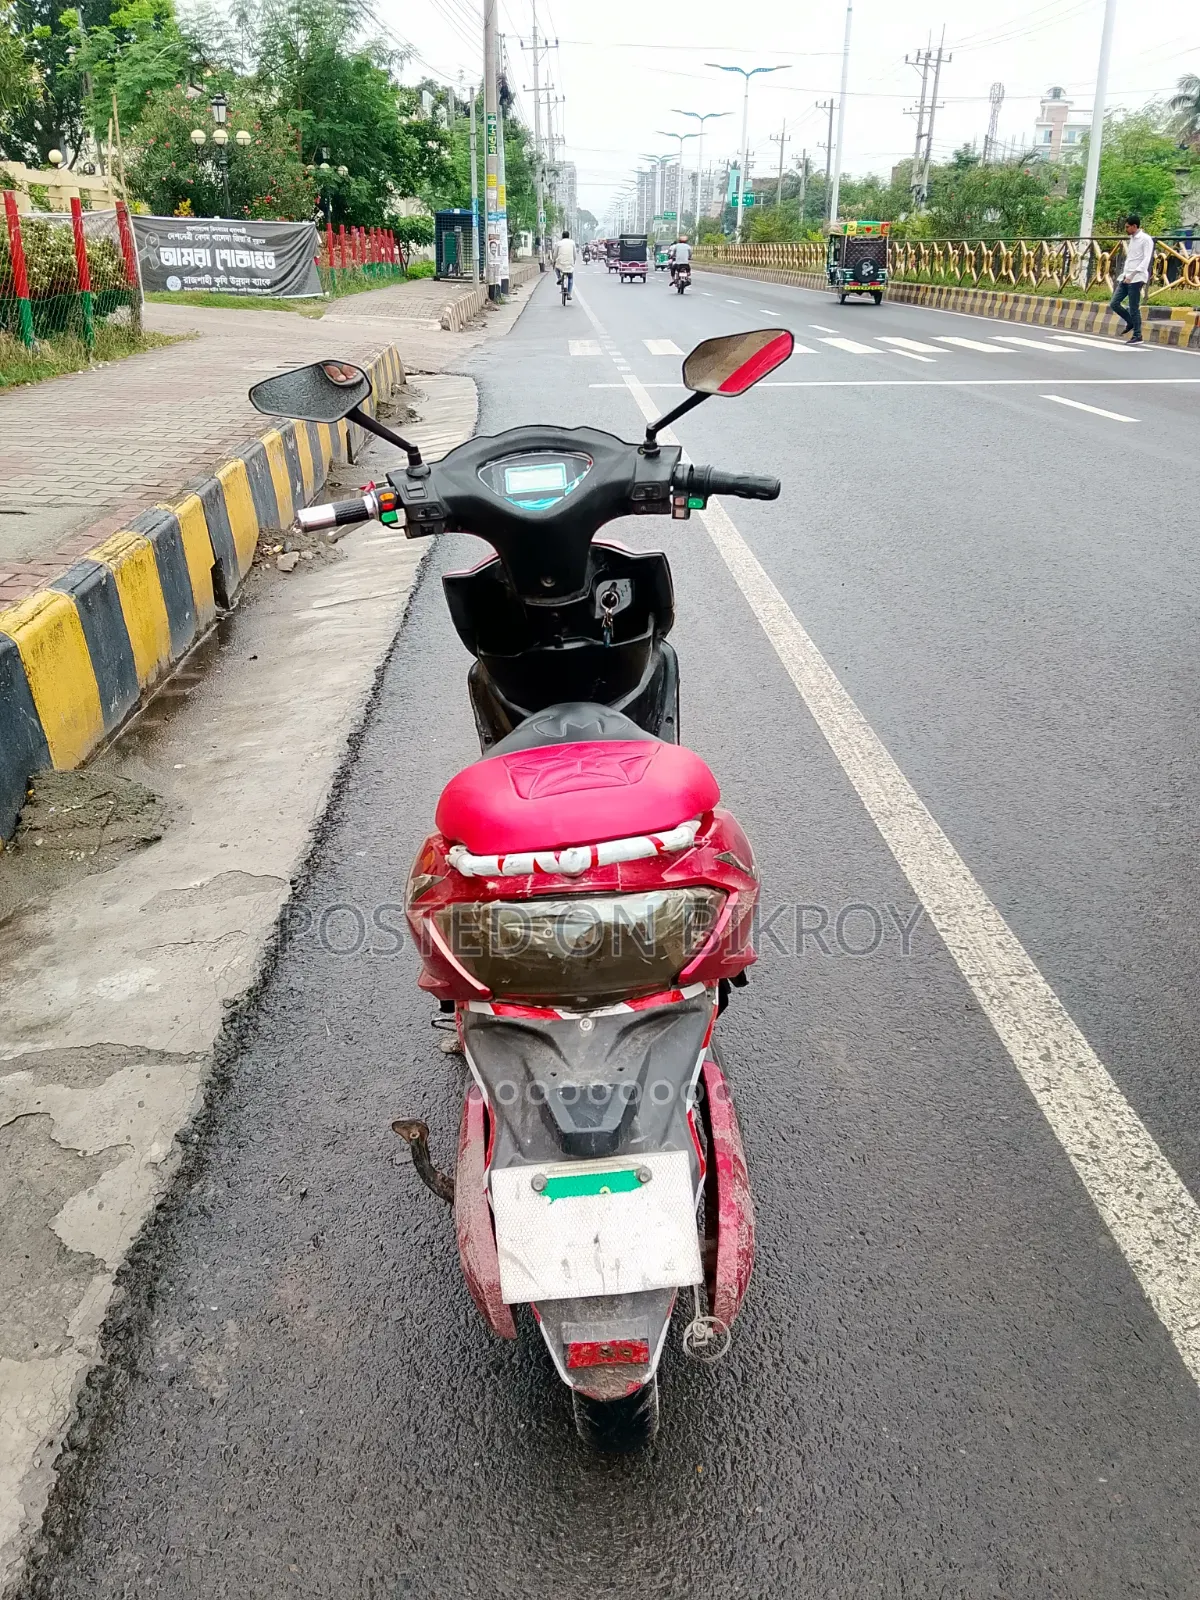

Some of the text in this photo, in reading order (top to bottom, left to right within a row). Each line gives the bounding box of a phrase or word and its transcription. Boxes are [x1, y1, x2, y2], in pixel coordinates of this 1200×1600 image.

[160, 247, 276, 270] আমরা শোকাহত
[182, 274, 212, 286] রাজশাহী
[213, 275, 228, 287] কৃষি
